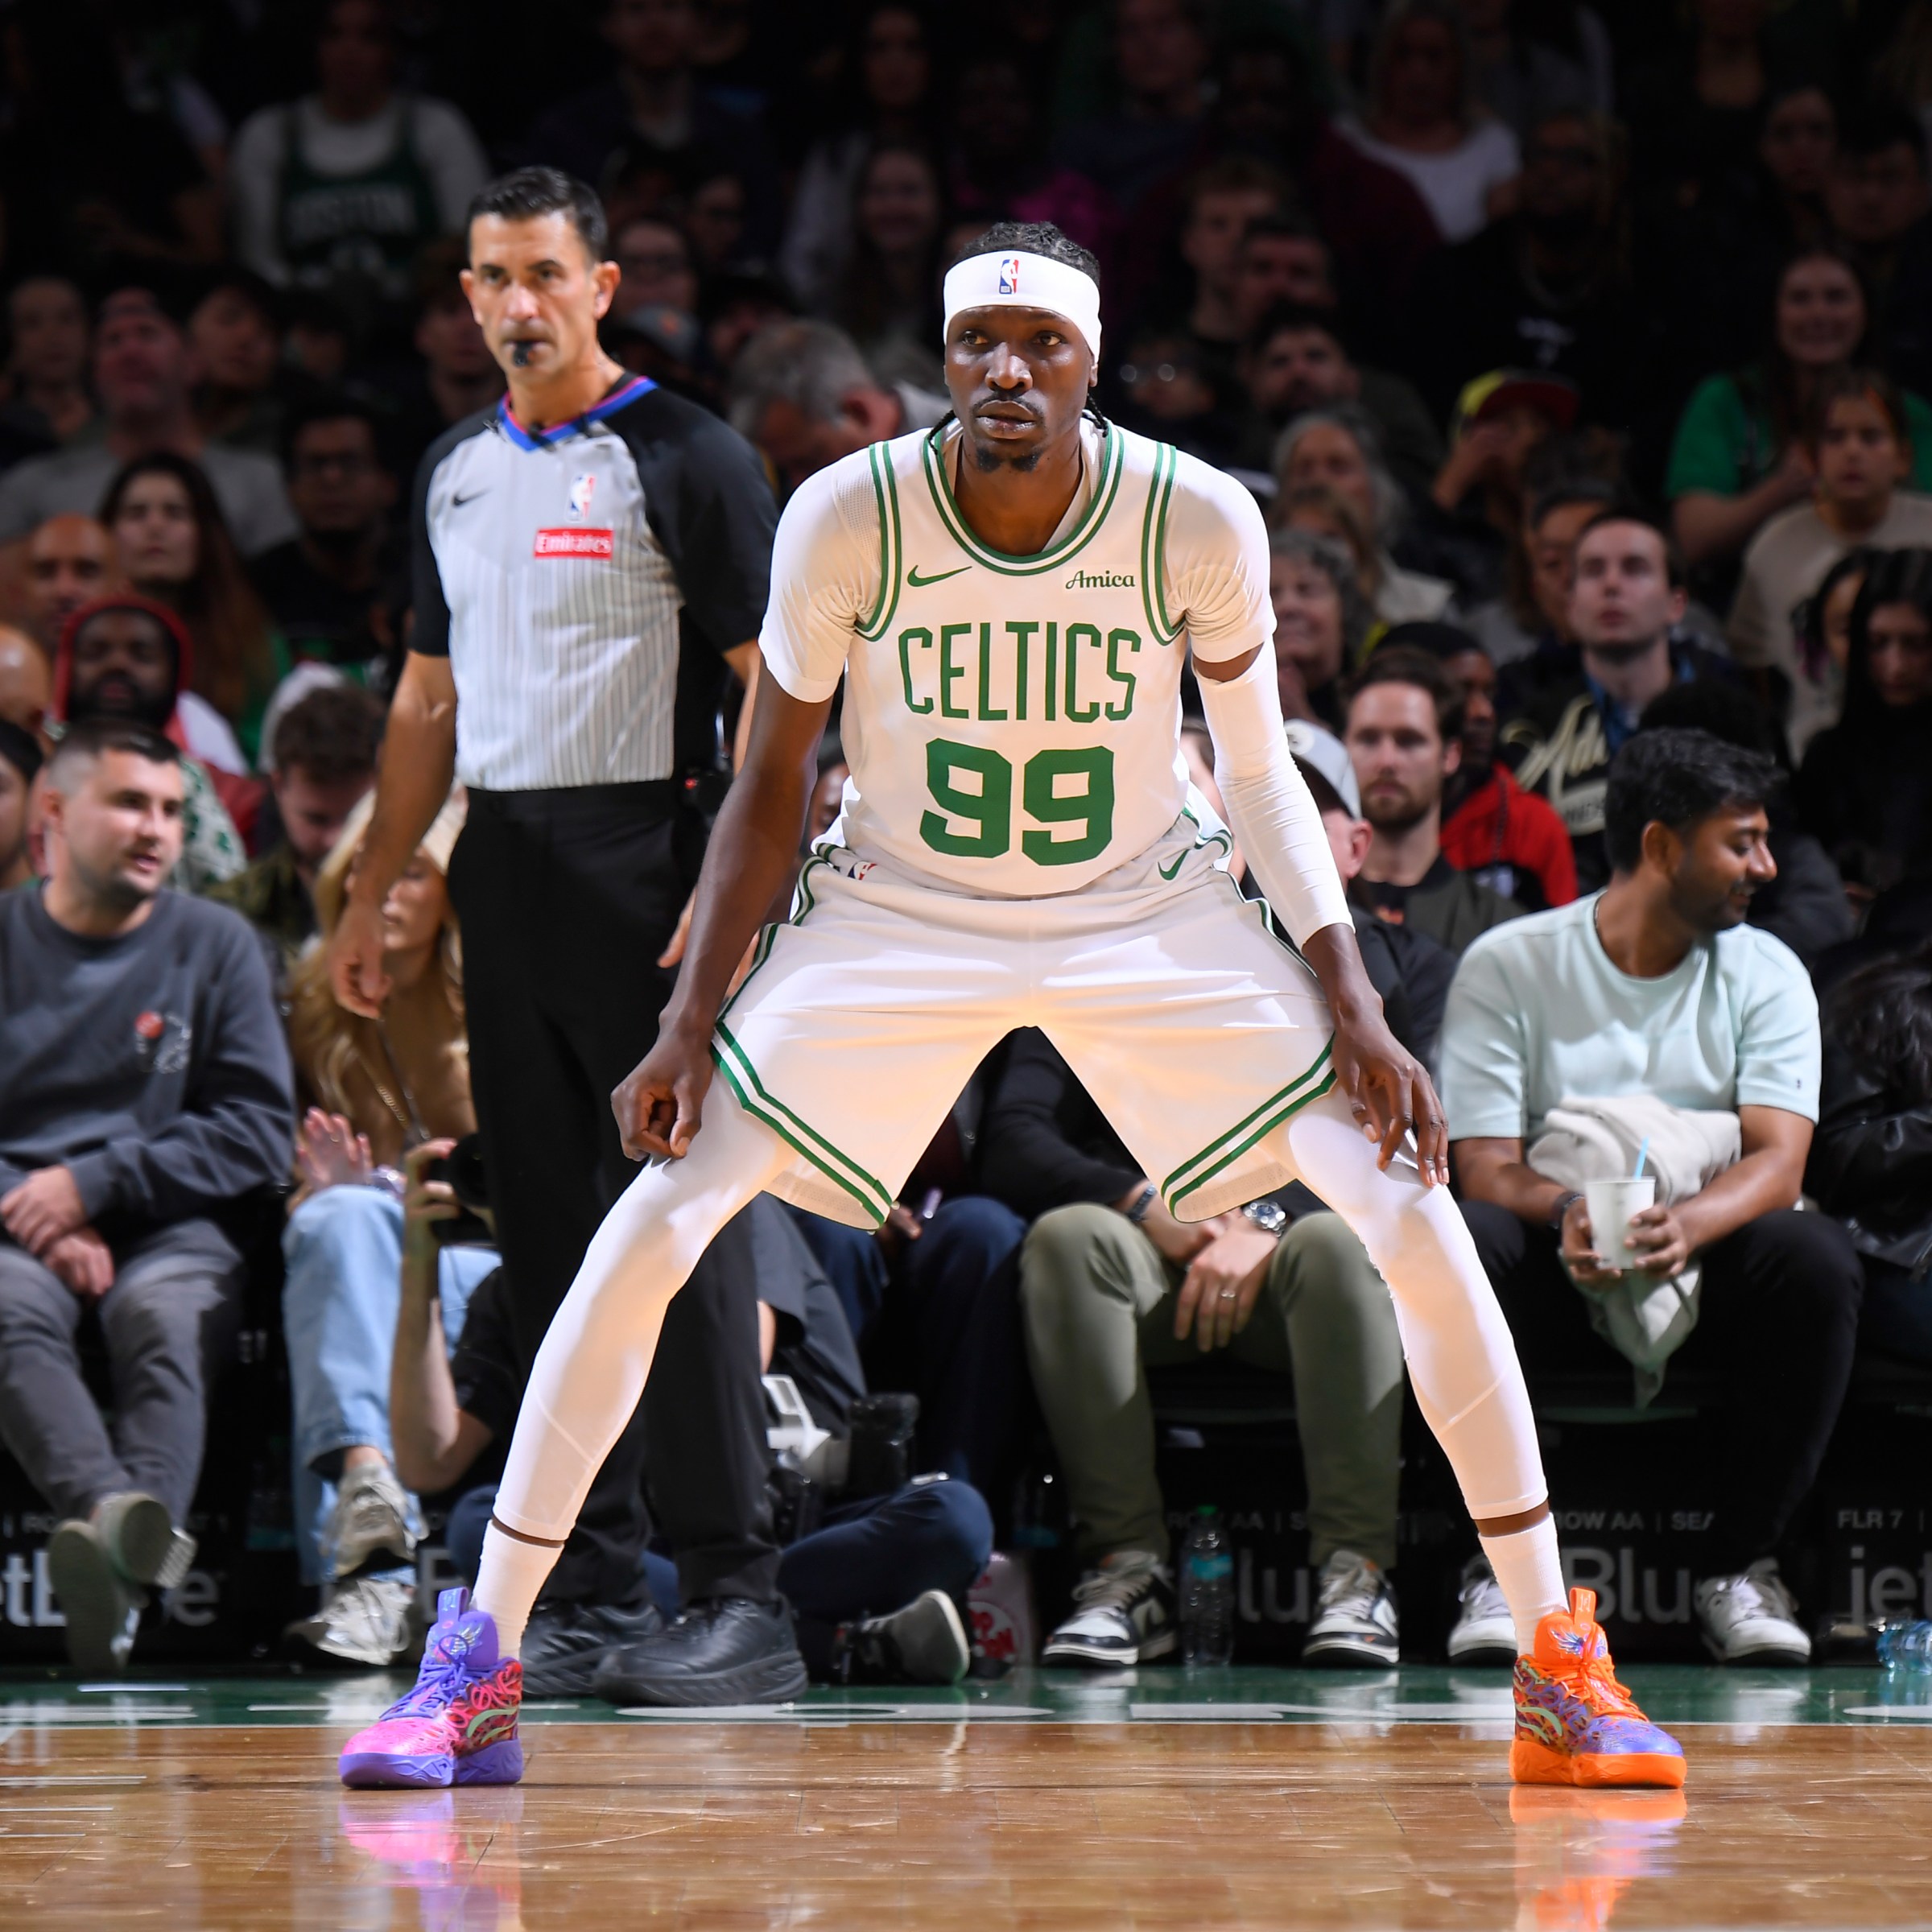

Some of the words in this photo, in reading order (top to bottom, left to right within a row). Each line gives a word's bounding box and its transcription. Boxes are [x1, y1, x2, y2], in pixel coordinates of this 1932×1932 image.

[535, 531, 611, 553] Emirates
[1065, 570, 1135, 589] Amica
[898, 621, 1141, 723] CELTICS
[919, 737, 1114, 865] 99
[1611, 1511, 1645, 1530] AA
[1837, 1509, 1884, 1530] FLR
[1890, 1509, 1905, 1530] 7
[1560, 1546, 1691, 1624] Blu
